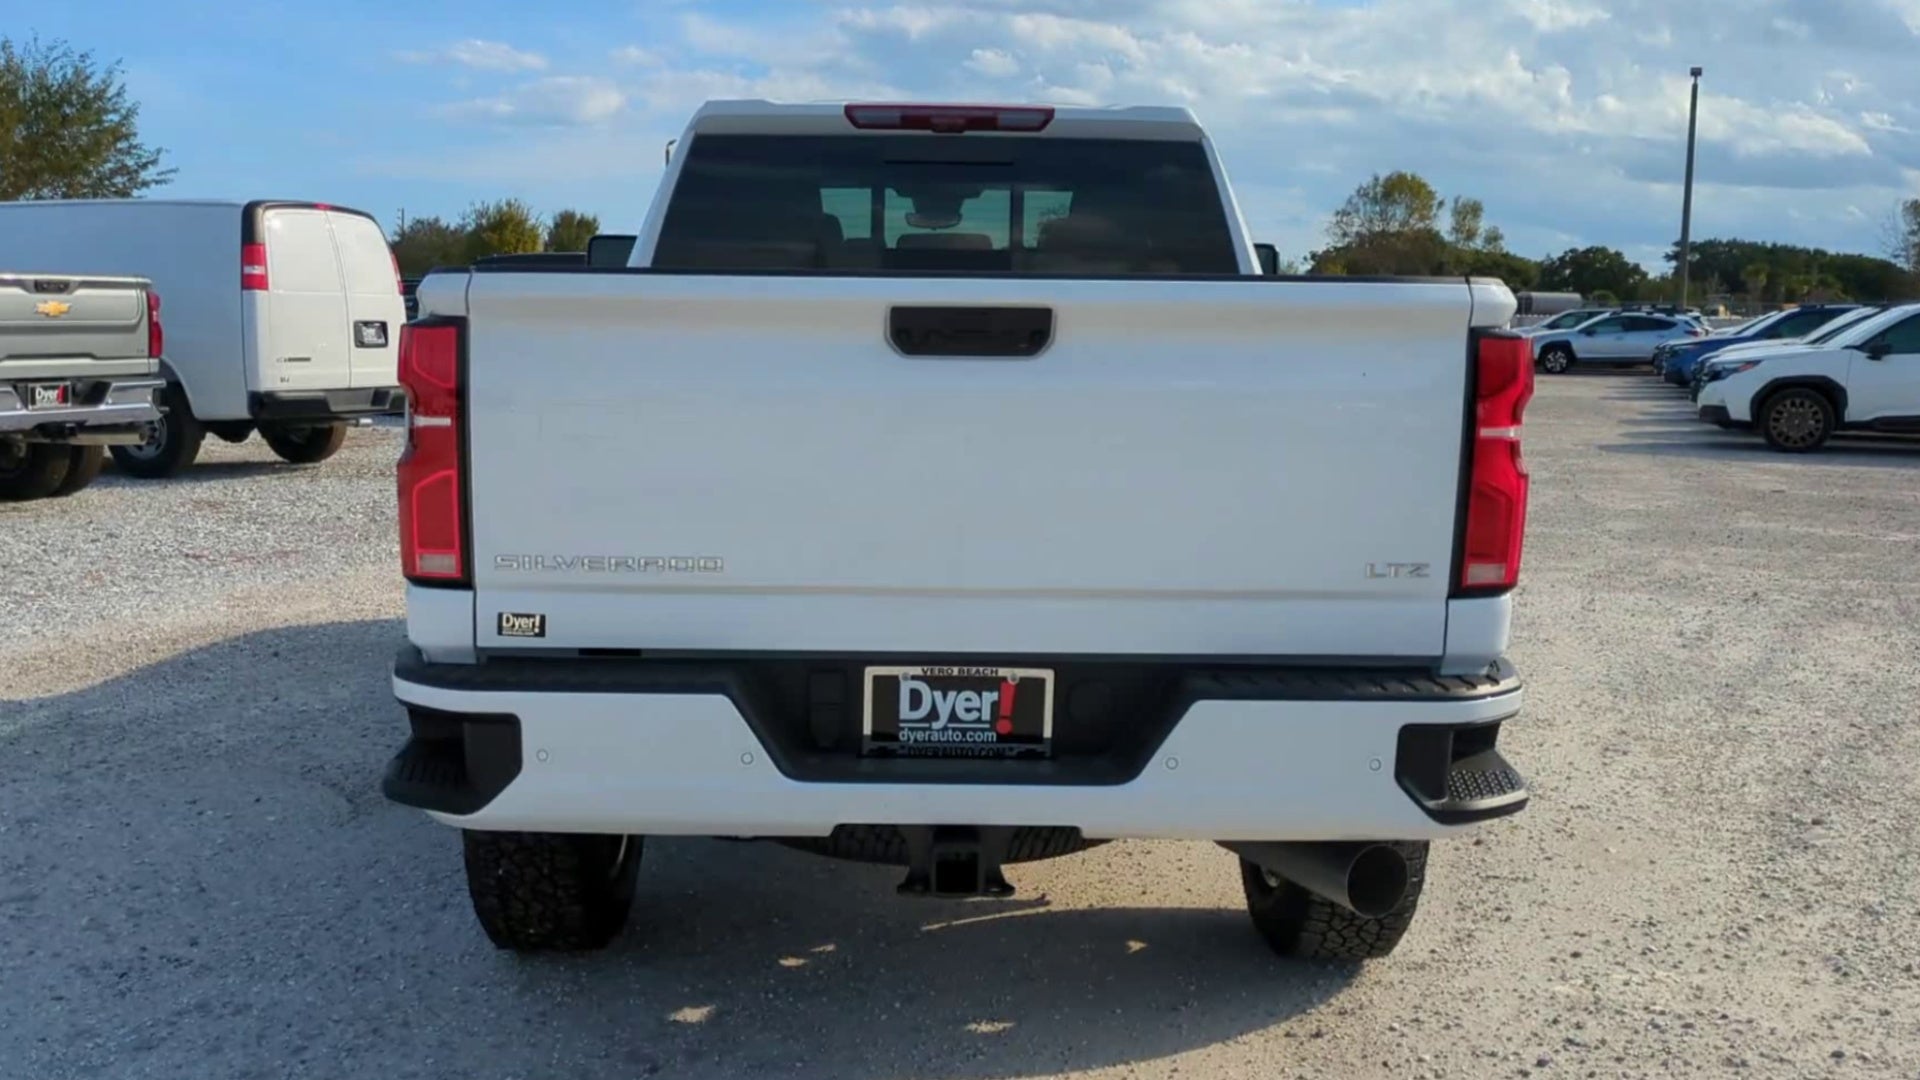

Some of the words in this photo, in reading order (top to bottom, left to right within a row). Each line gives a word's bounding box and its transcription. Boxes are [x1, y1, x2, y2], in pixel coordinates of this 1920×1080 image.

[494, 554, 724, 573] SILVERADO
[1365, 562, 1430, 578] LTZ
[502, 613, 540, 634] Dyer!
[921, 667, 955, 677] VERO
[958, 667, 999, 677] BEACH
[899, 680, 1016, 735] Dyer!
[899, 729, 997, 743] dyerauto.com
